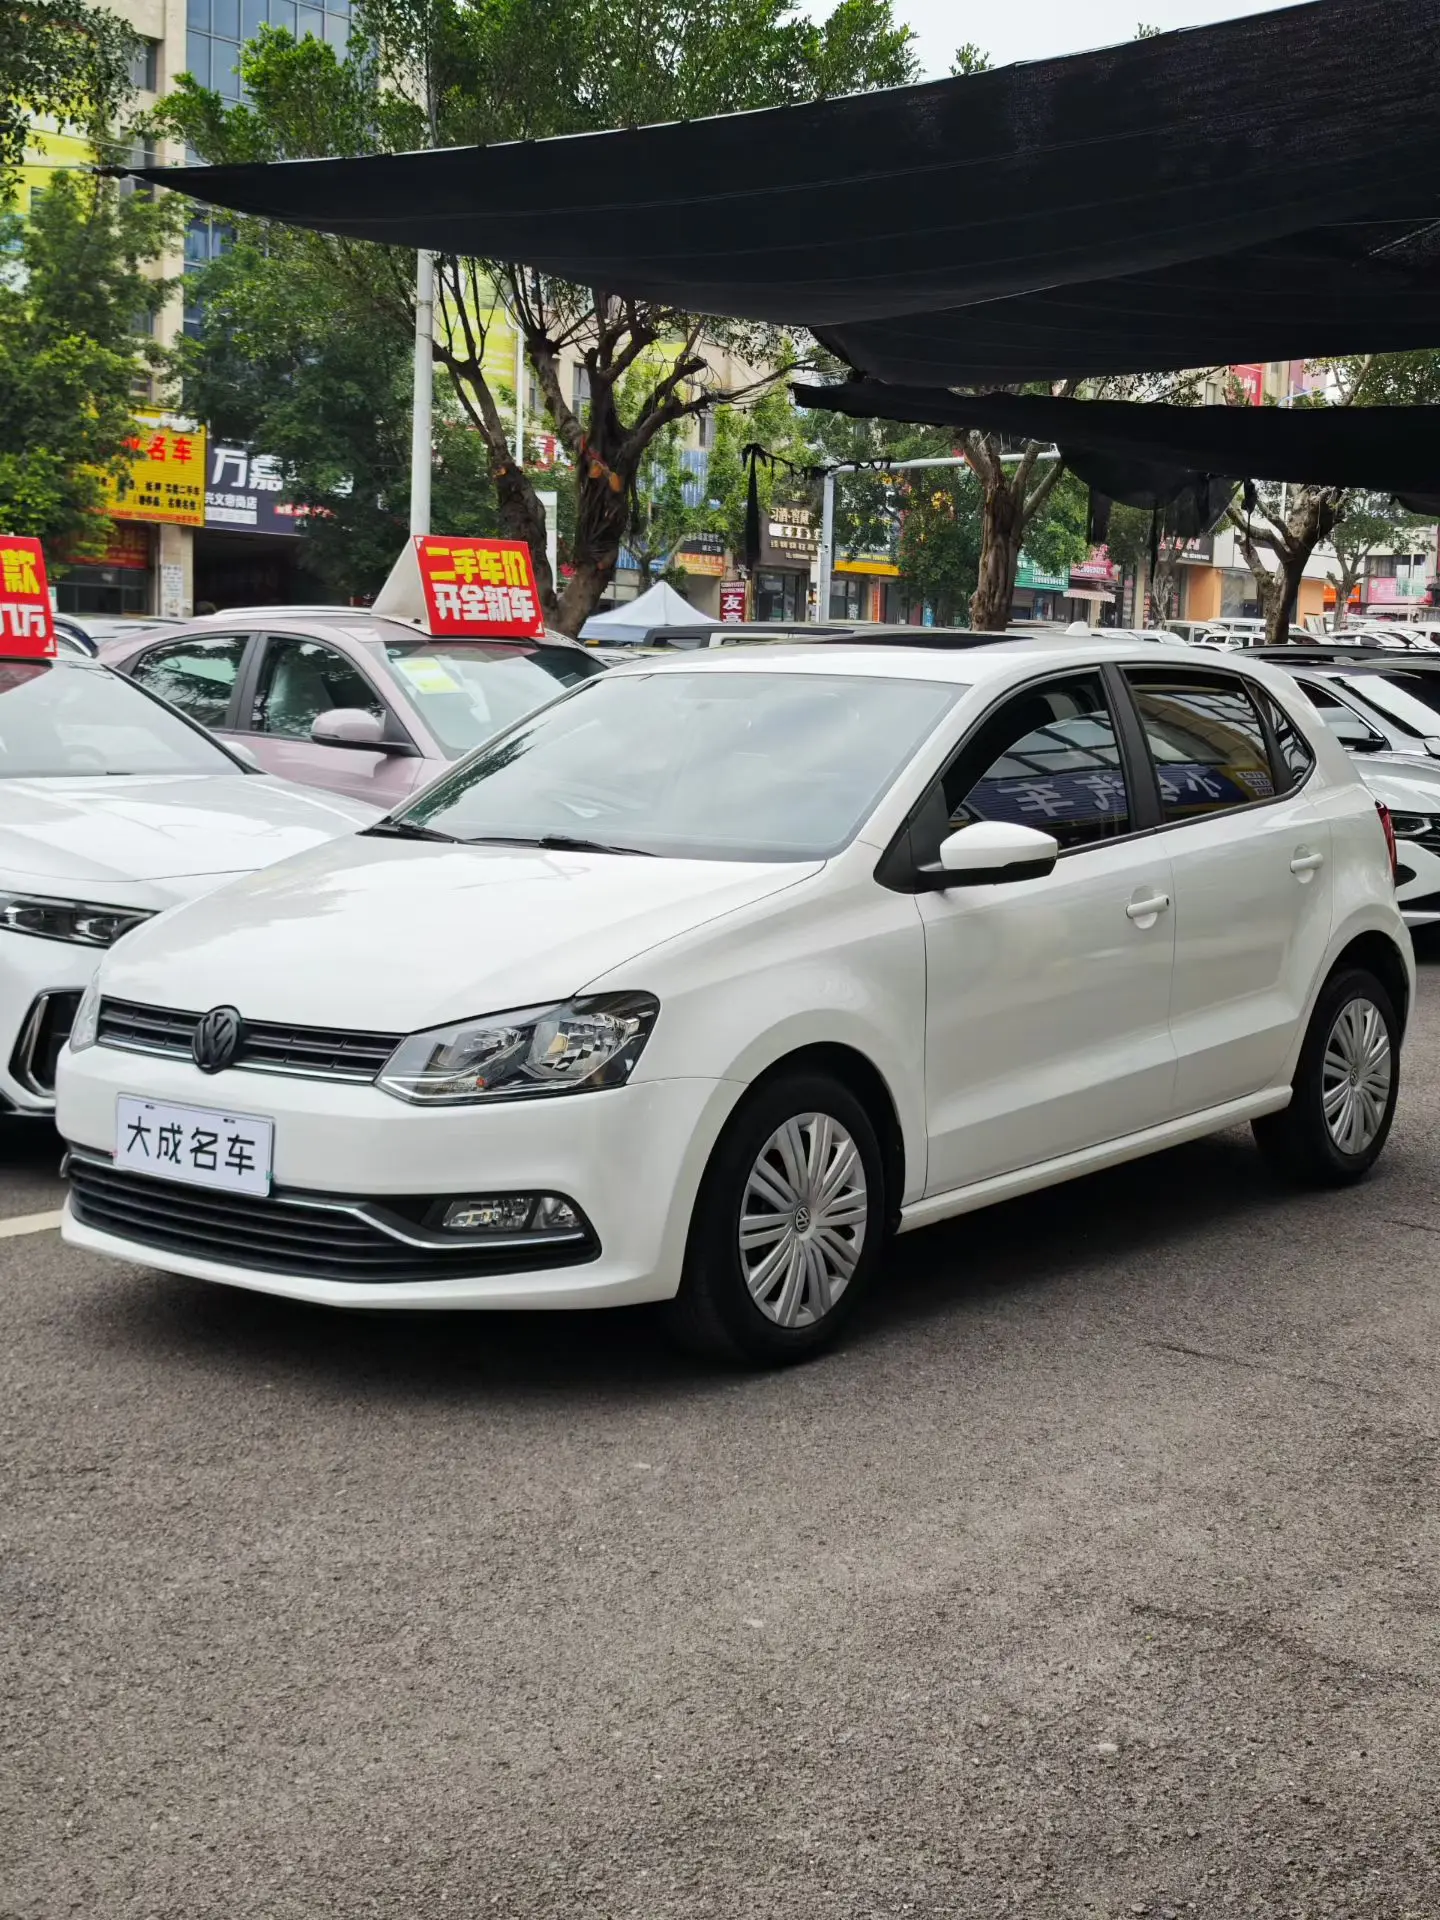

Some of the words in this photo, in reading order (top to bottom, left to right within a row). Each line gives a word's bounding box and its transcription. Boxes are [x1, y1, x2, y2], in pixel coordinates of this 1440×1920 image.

[425, 546, 529, 587] 二手车价
[431, 582, 536, 623] 开全新车
[127, 1115, 256, 1176] 大成名车
